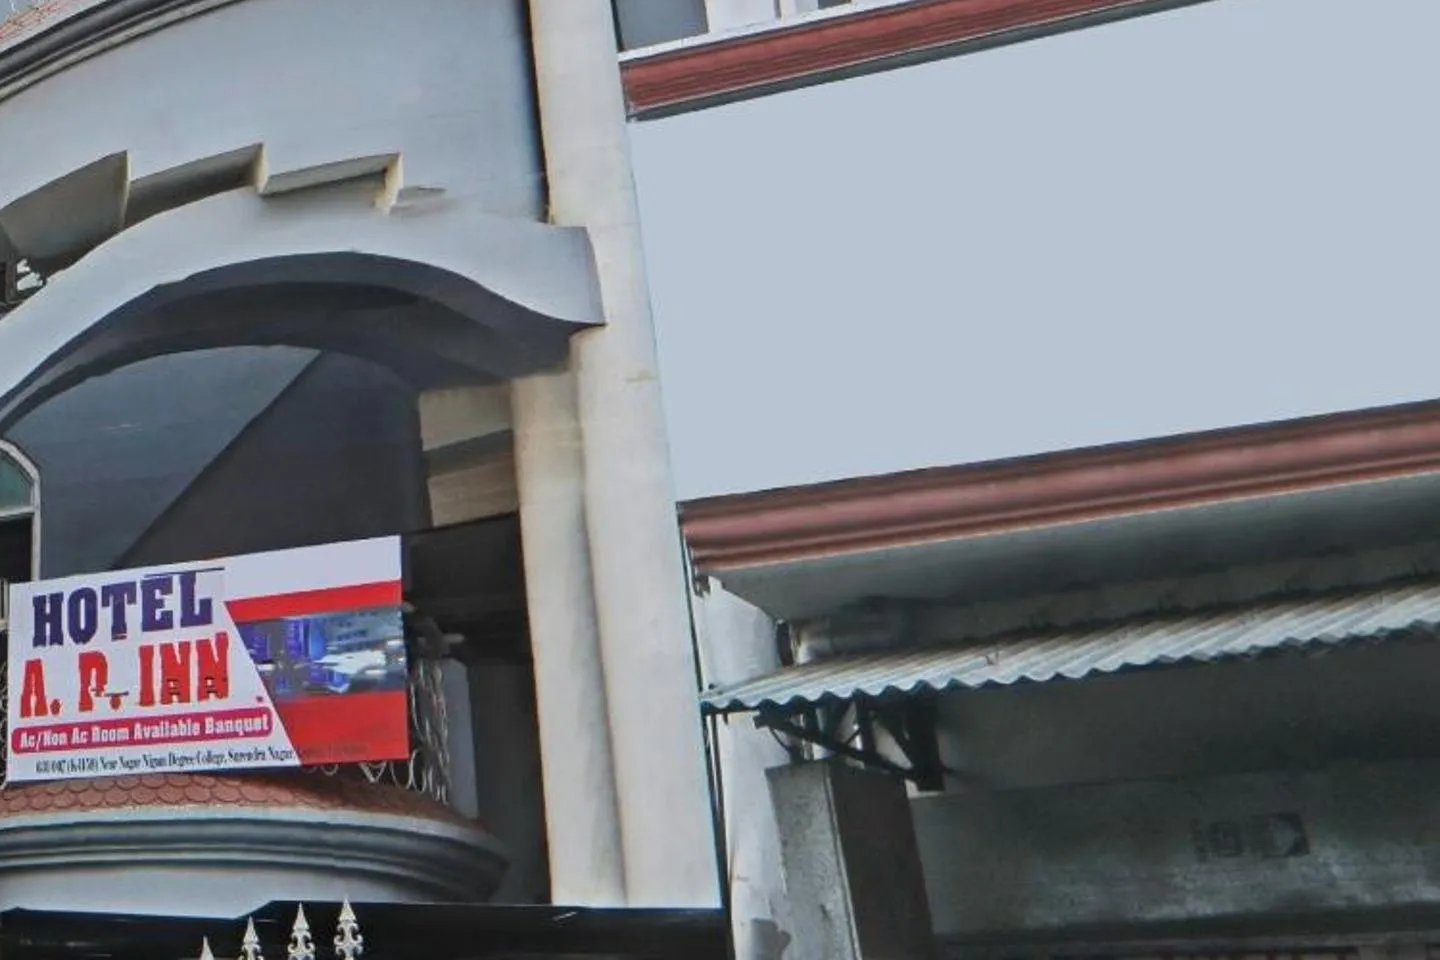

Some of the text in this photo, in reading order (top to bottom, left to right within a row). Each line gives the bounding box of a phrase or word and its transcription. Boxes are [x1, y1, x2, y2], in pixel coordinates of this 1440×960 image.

[32, 572, 213, 647] HOTEL
[20, 658, 62, 719] A.
[137, 632, 230, 707] INN
[20, 713, 268, 751] Ac/Non Ac Room Available Banquet
